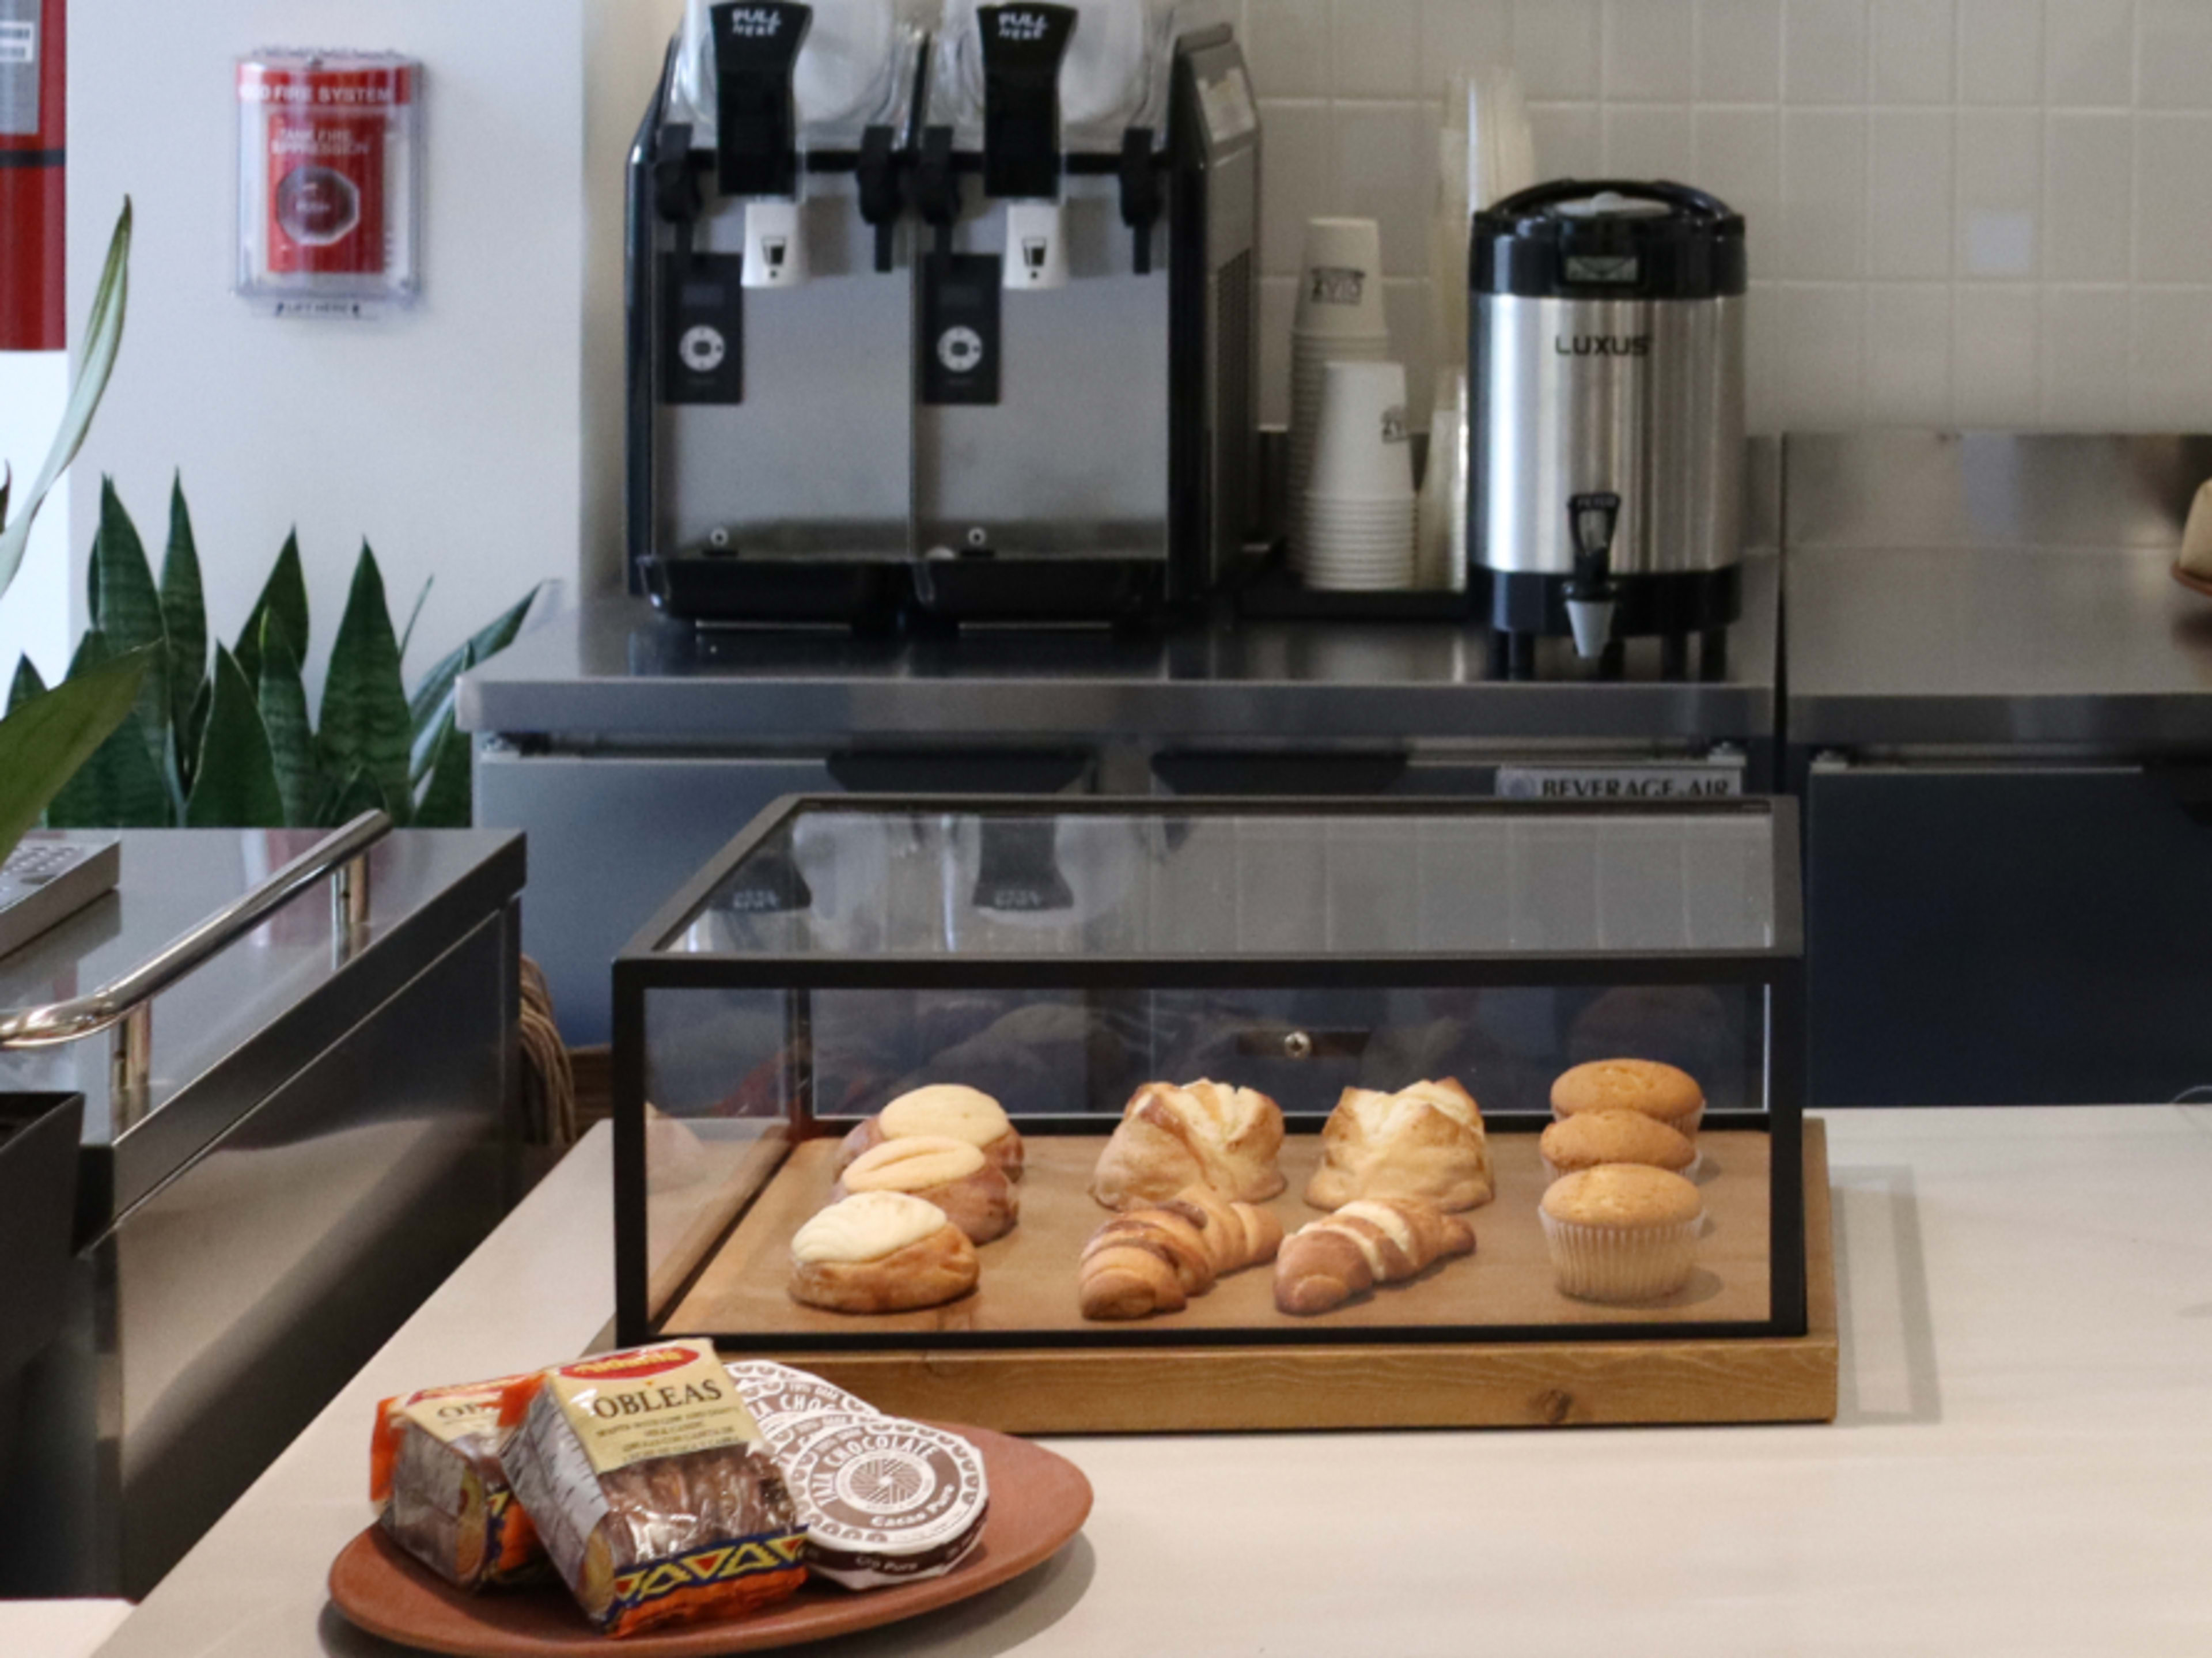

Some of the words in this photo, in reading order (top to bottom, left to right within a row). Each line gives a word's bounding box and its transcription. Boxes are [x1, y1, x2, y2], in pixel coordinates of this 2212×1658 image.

[274, 86, 310, 100] FIRE
[318, 87, 392, 100] SYSTEM
[1555, 335, 1649, 355] LUXUS
[593, 1379, 722, 1419] OBLEAS
[823, 1436, 940, 1467] CHOCOLATE
[870, 1510, 927, 1528] Cacao
